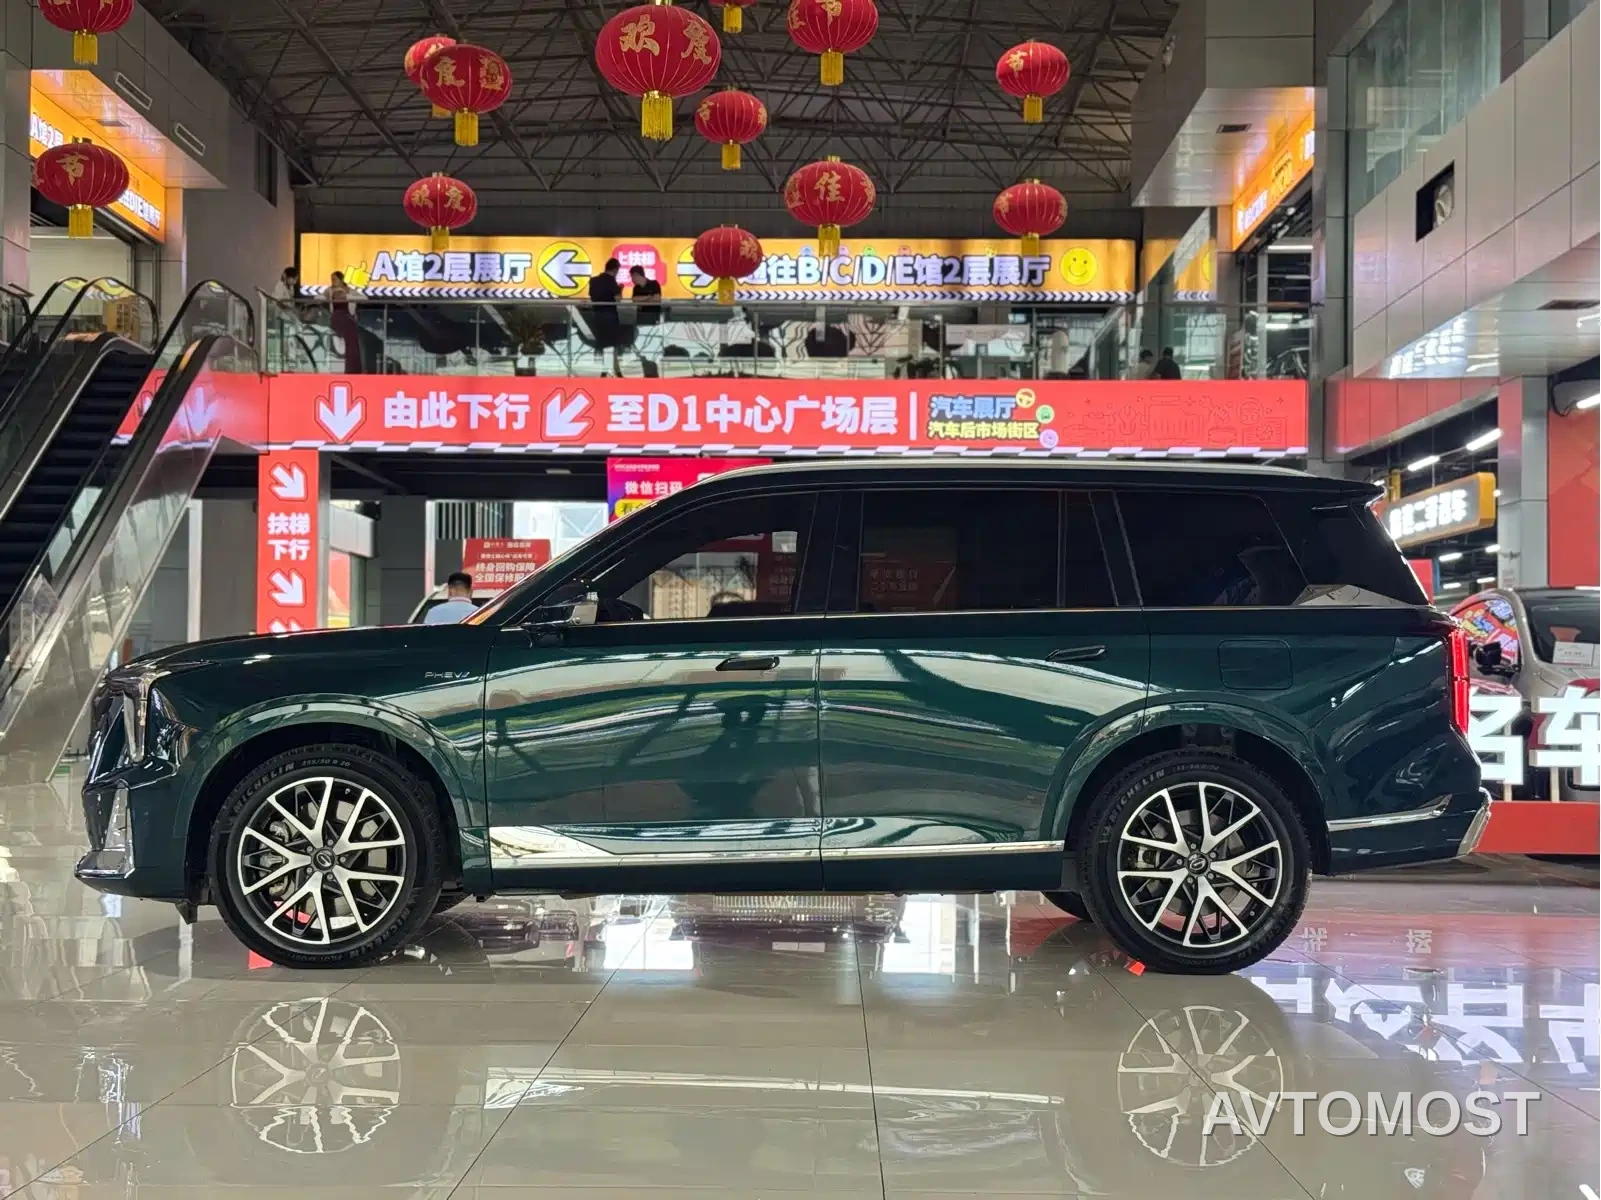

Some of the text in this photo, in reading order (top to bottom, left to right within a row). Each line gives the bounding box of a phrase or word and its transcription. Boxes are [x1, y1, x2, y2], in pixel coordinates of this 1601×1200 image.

[371, 249, 533, 284] A馆2层展厅
[383, 391, 531, 430] 由此下行
[606, 393, 899, 435] 至D1中心广场层
[928, 395, 1016, 419] 汽车展厅
[927, 420, 1040, 440] 汽车后市场街区
[267, 512, 311, 536] 扶梯
[267, 540, 311, 562] 下行
[424, 671, 463, 679] PHEV
[233, 762, 295, 813] MICHELIN
[1109, 770, 1165, 823] MICHELIN
